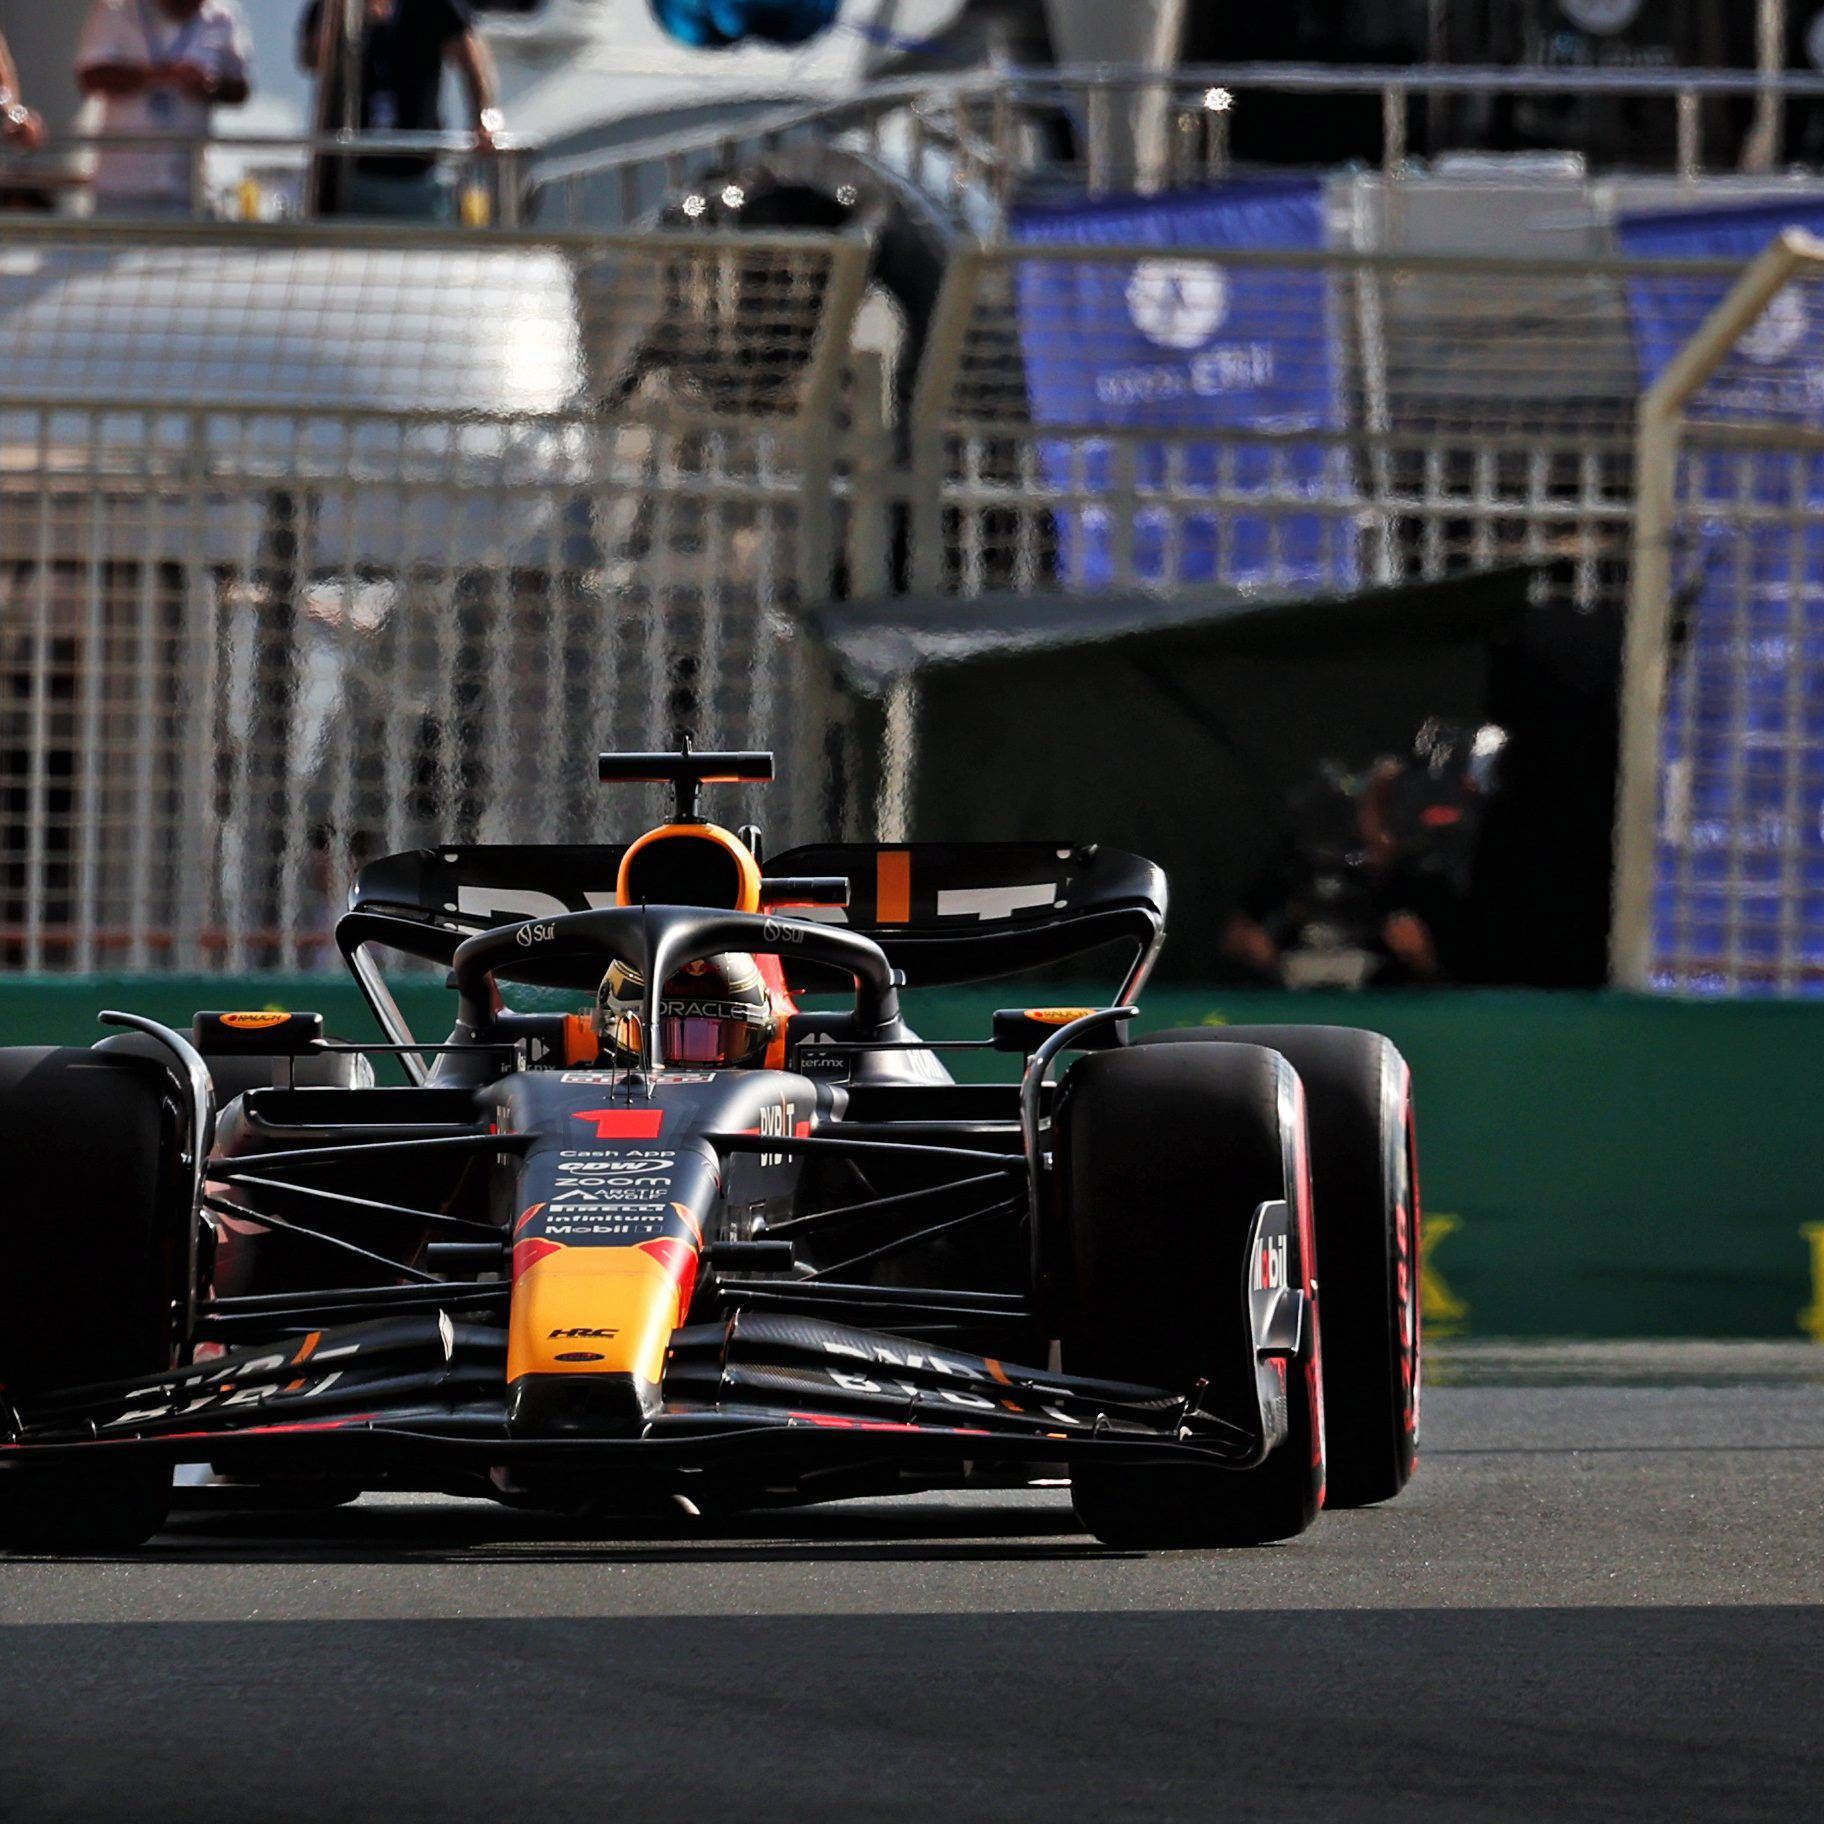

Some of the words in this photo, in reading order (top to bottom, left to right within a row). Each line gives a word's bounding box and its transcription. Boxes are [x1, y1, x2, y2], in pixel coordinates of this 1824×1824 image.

[533, 922, 556, 942] Sui
[570, 1109, 664, 1139] 1
[559, 1150, 619, 1158] Cash
[626, 1150, 676, 1158] App
[558, 1160, 658, 1172] CDW
[554, 1177, 672, 1187] zoom
[545, 1225, 629, 1234] Mobil
[546, 1327, 620, 1340] HRC
